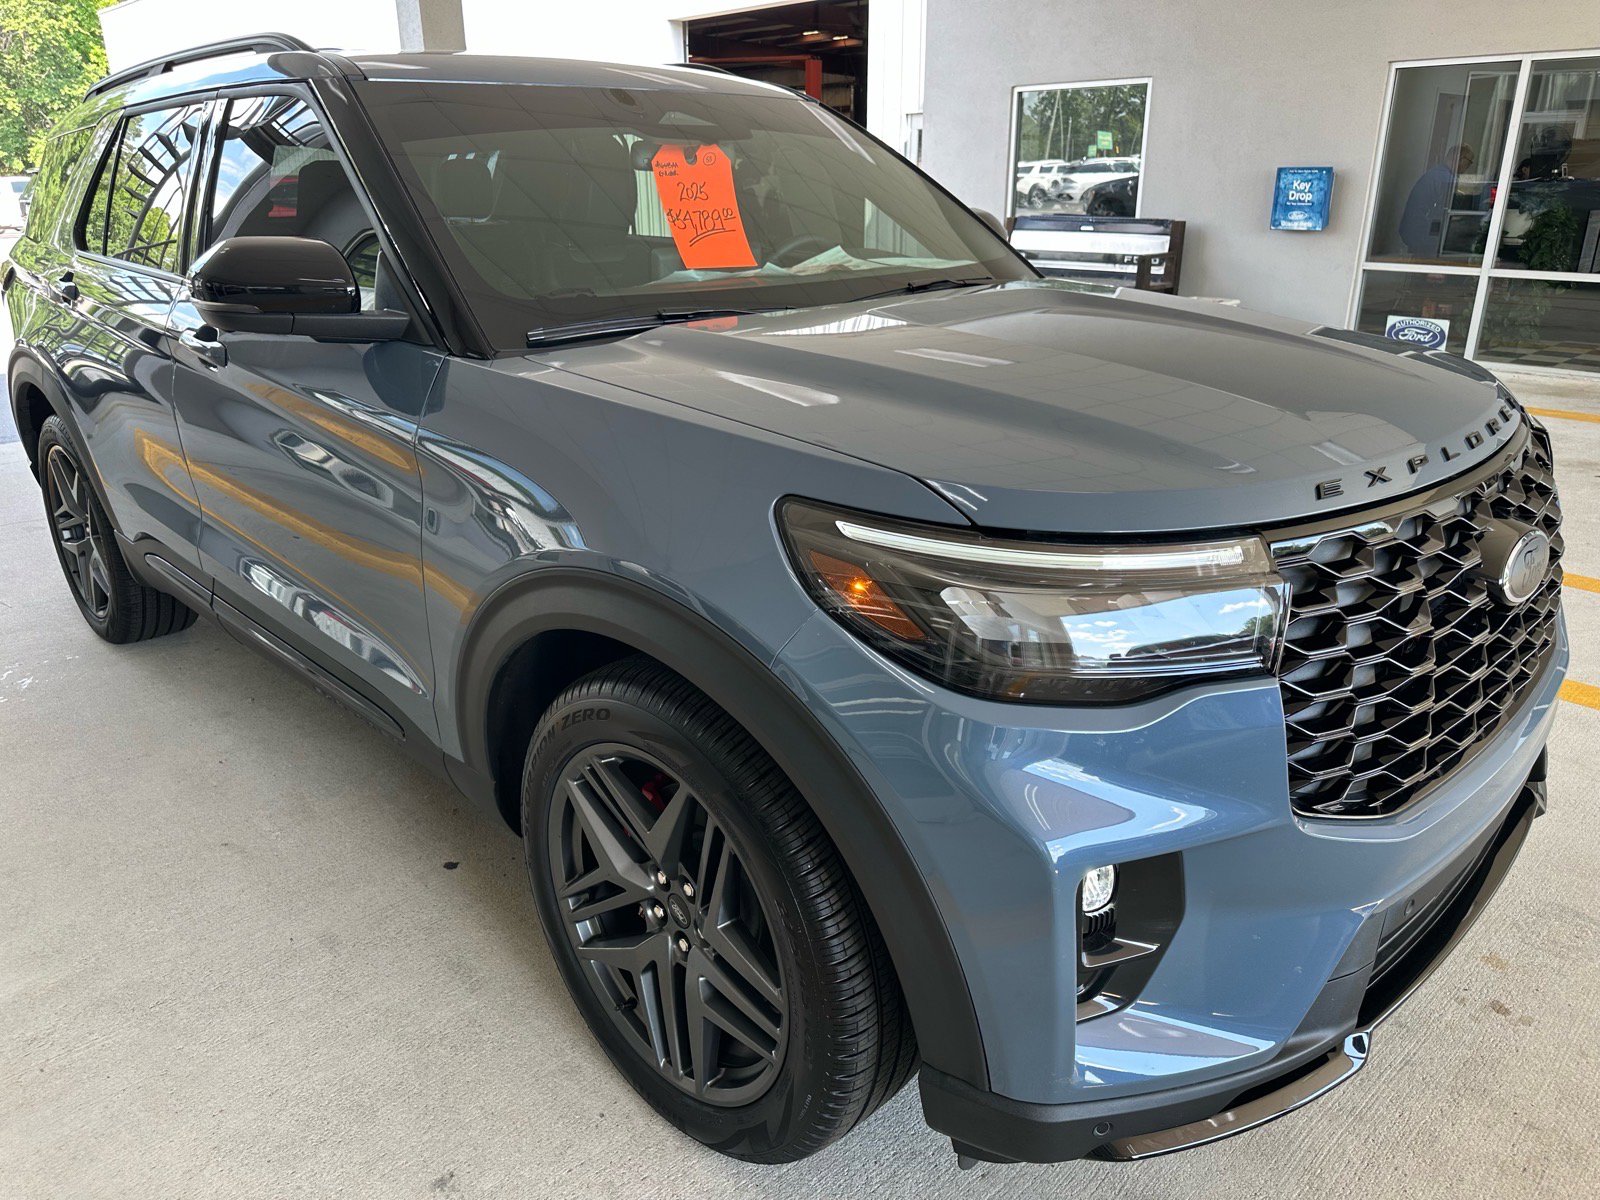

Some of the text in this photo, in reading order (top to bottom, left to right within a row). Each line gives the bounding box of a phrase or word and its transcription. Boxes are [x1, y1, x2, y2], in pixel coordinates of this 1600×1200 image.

[677, 181, 709, 201] 2025
[1293, 179, 1312, 192] Key
[1288, 190, 1313, 203] Drop
[1123, 255, 1160, 265] FOD
[1395, 319, 1441, 333] AUTHORIZED
[1398, 327, 1434, 342] Ford
[561, 708, 612, 731] ZERO
